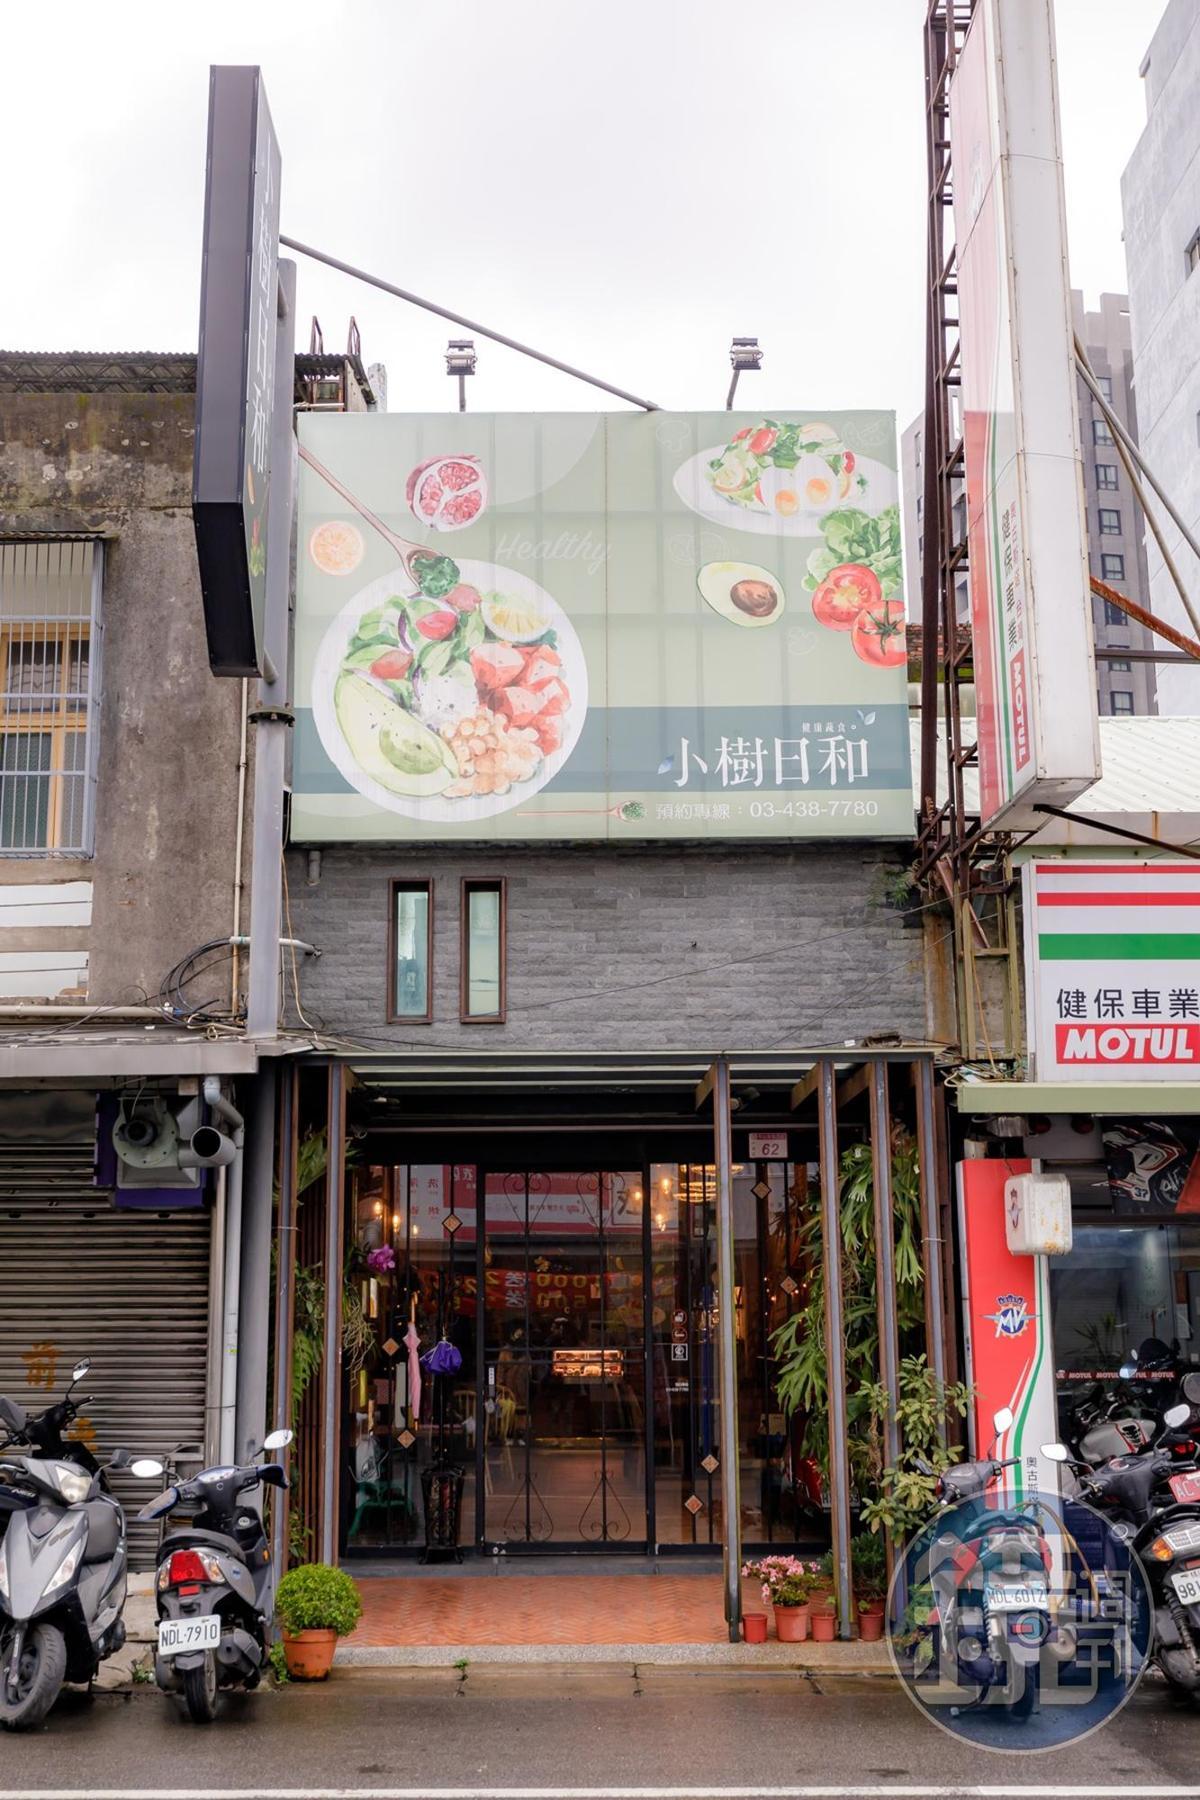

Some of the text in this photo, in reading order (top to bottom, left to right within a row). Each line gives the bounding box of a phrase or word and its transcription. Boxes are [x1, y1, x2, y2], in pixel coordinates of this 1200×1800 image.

[495, 530, 614, 576] Healthy
[1014, 661, 1026, 763] MOTUL
[674, 735, 869, 788] 小樹日和
[1056, 988, 1200, 1019] 健保車業
[1063, 1027, 1194, 1060] MOTUL
[762, 1143, 780, 1156] 62
